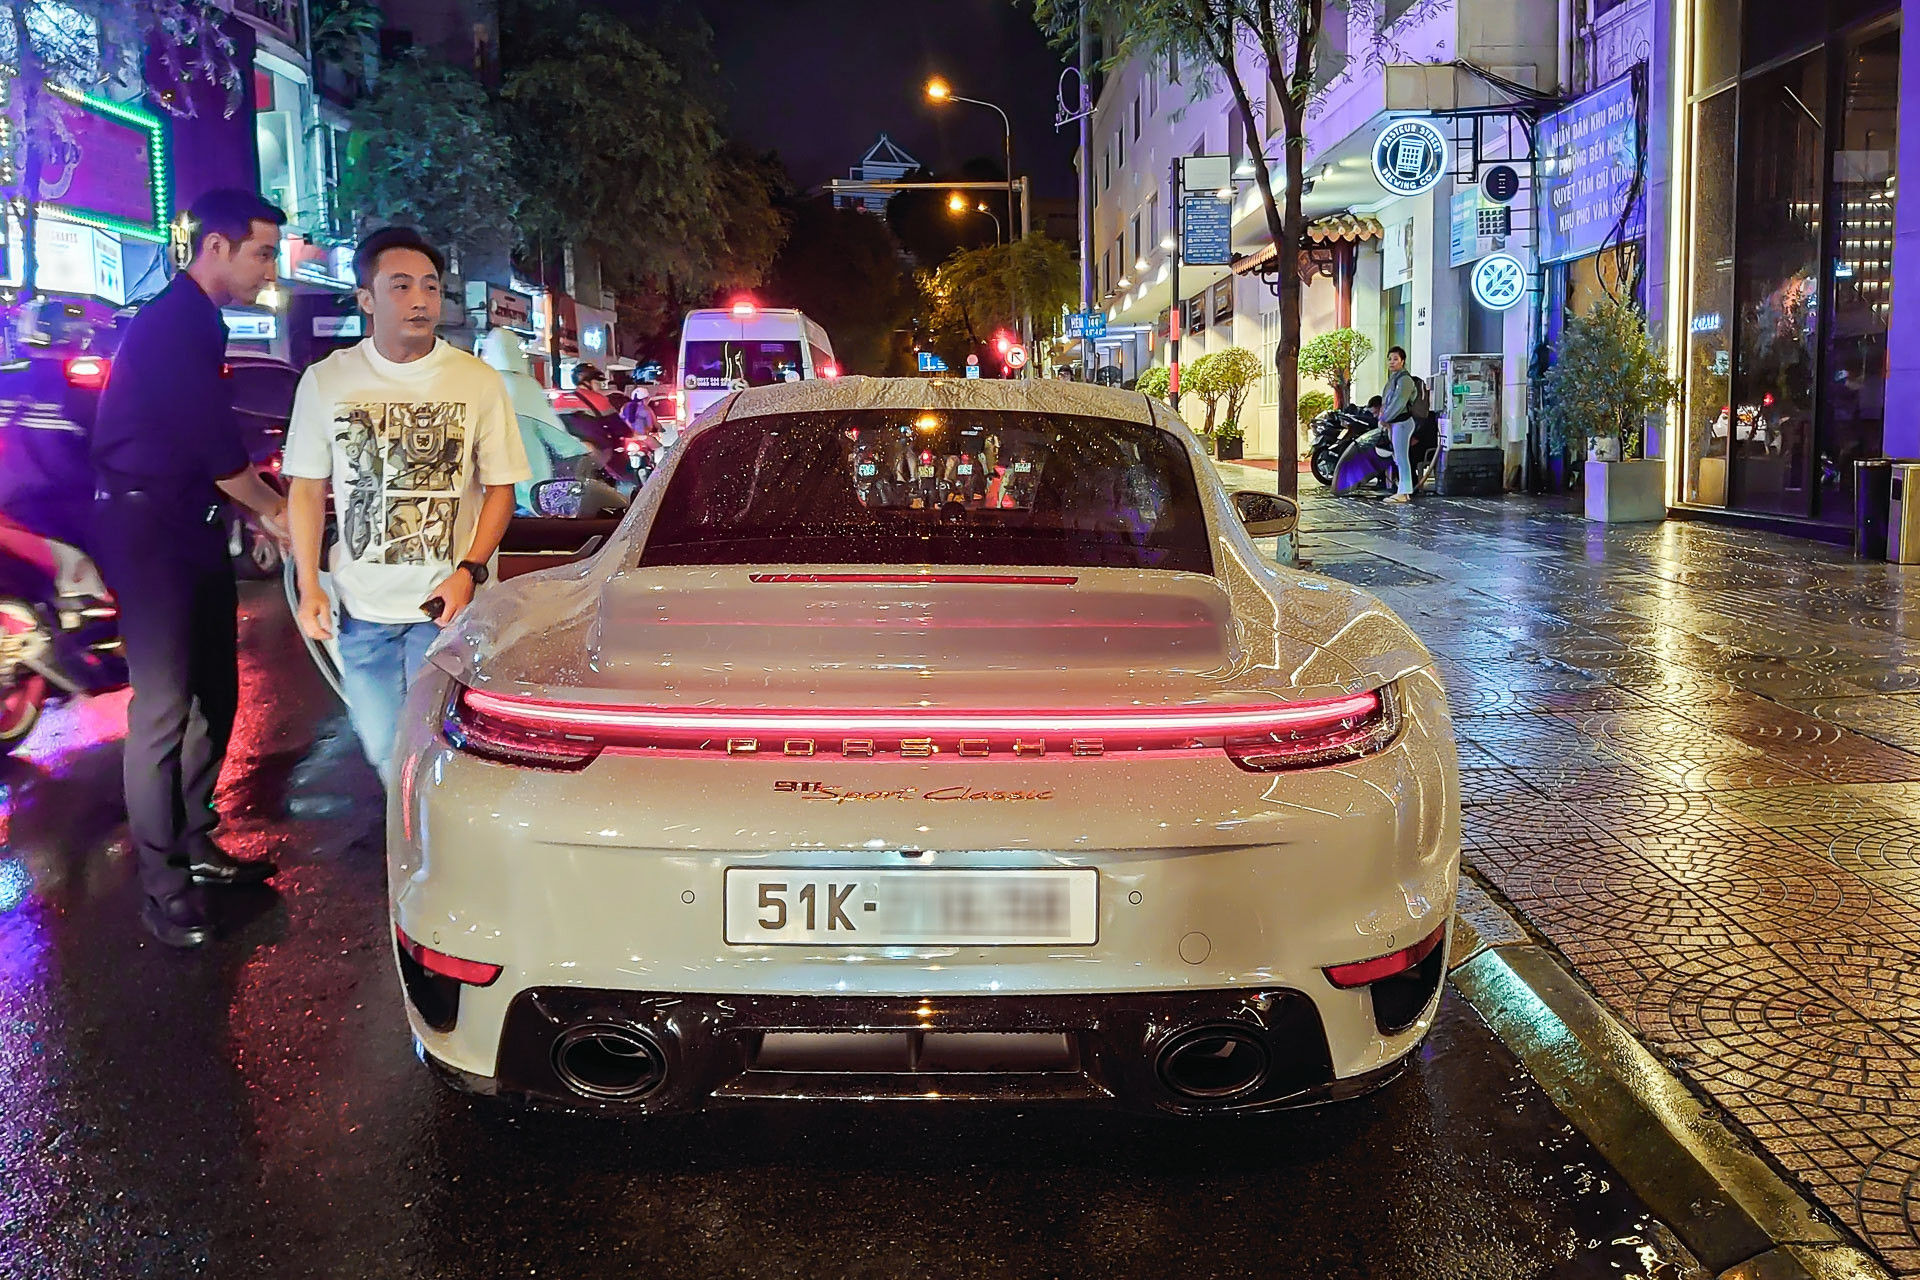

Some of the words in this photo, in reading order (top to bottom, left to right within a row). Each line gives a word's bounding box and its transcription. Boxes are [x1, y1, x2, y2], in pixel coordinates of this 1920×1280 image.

[1573, 117, 1589, 140] DÂN
[1590, 109, 1606, 132] KHU
[1607, 94, 1625, 124] PHỐ
[1626, 97, 1633, 116] 6
[1381, 124, 1417, 148] PASTEUR
[1419, 126, 1442, 153] STREET
[1589, 138, 1605, 163] BẾN
[1381, 167, 1417, 190] BREWING
[1553, 177, 1576, 208] QUYẾT
[1577, 174, 1594, 197] TÂM
[1596, 165, 1609, 191] GIỮ
[1559, 212, 1574, 233] KHU
[1576, 201, 1591, 227] PHỐ
[1592, 199, 1609, 221] VĂN
[727, 736, 1105, 757] PORSCHE
[801, 784, 919, 805] Sport
[922, 785, 1054, 803] Classic
